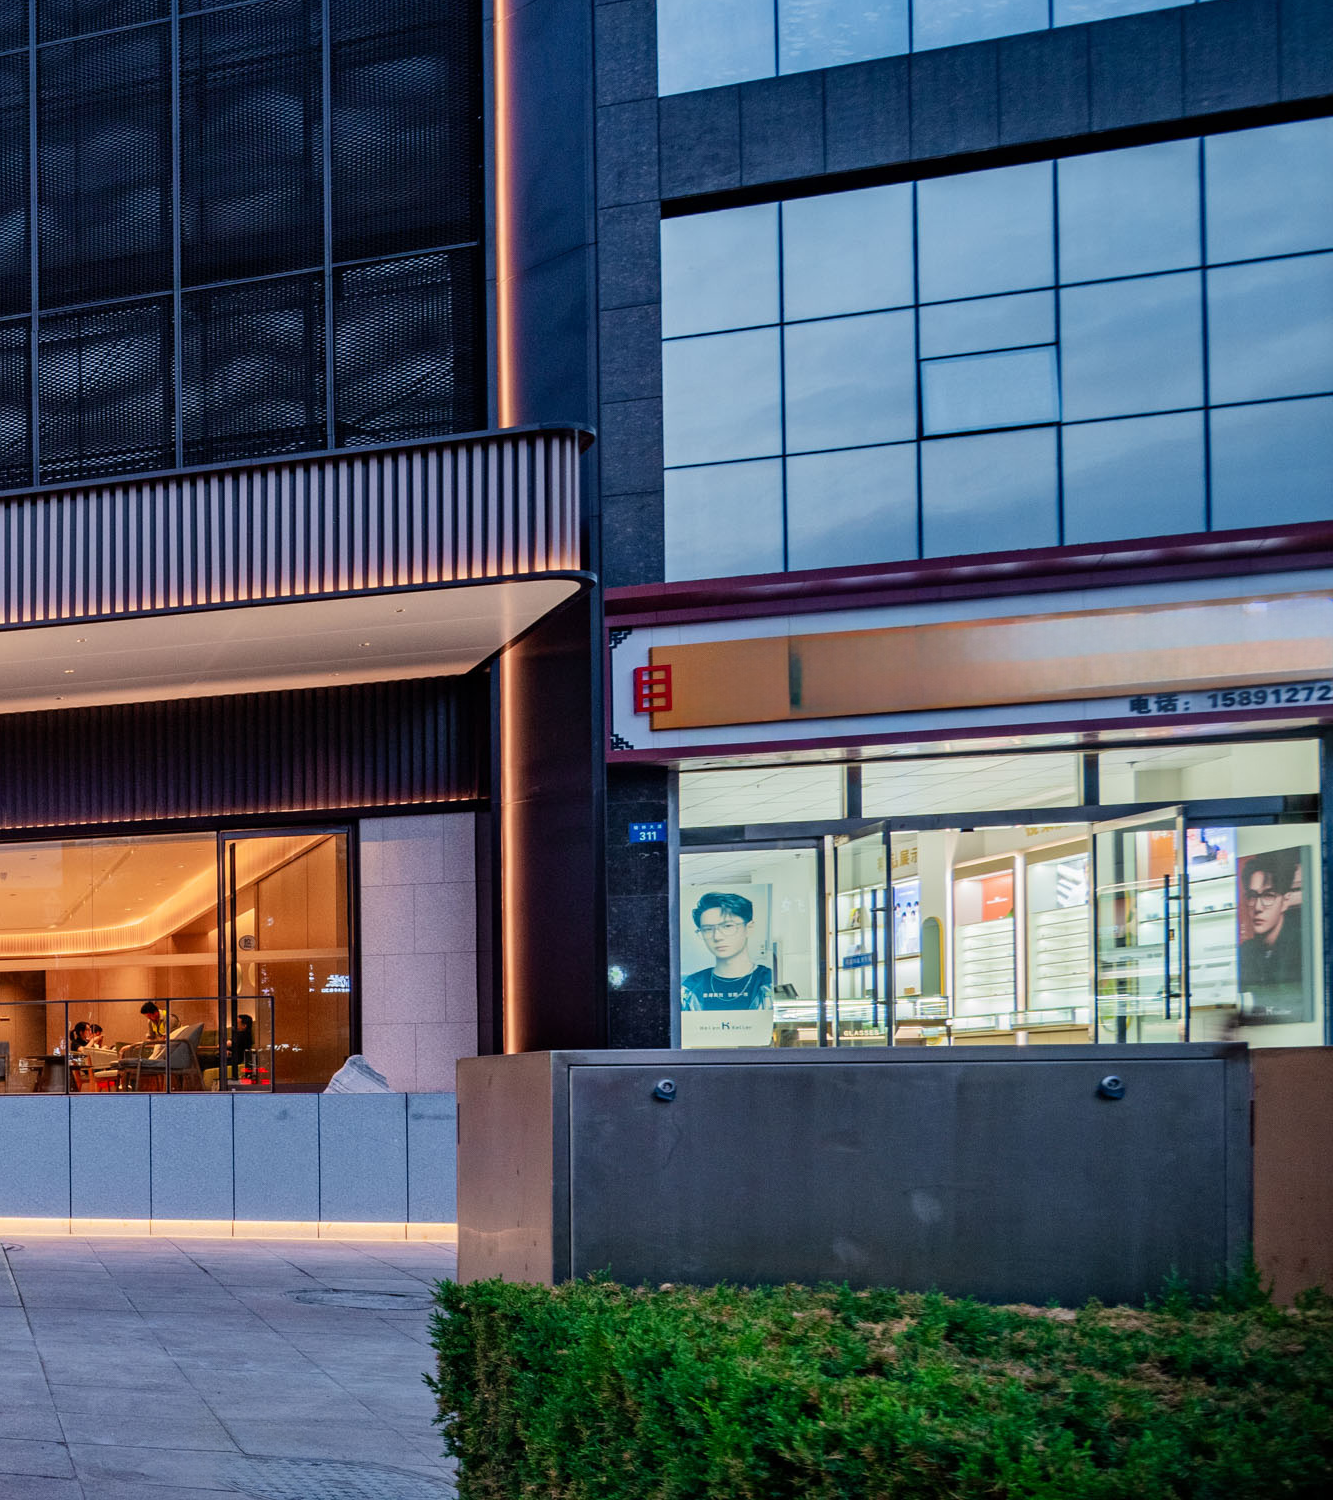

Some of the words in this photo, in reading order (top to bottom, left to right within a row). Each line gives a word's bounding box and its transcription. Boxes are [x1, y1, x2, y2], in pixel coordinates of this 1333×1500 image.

[1206, 684, 1333, 709] 15891272
[639, 831, 657, 841] 311
[844, 1029, 879, 1037] GLASSES
